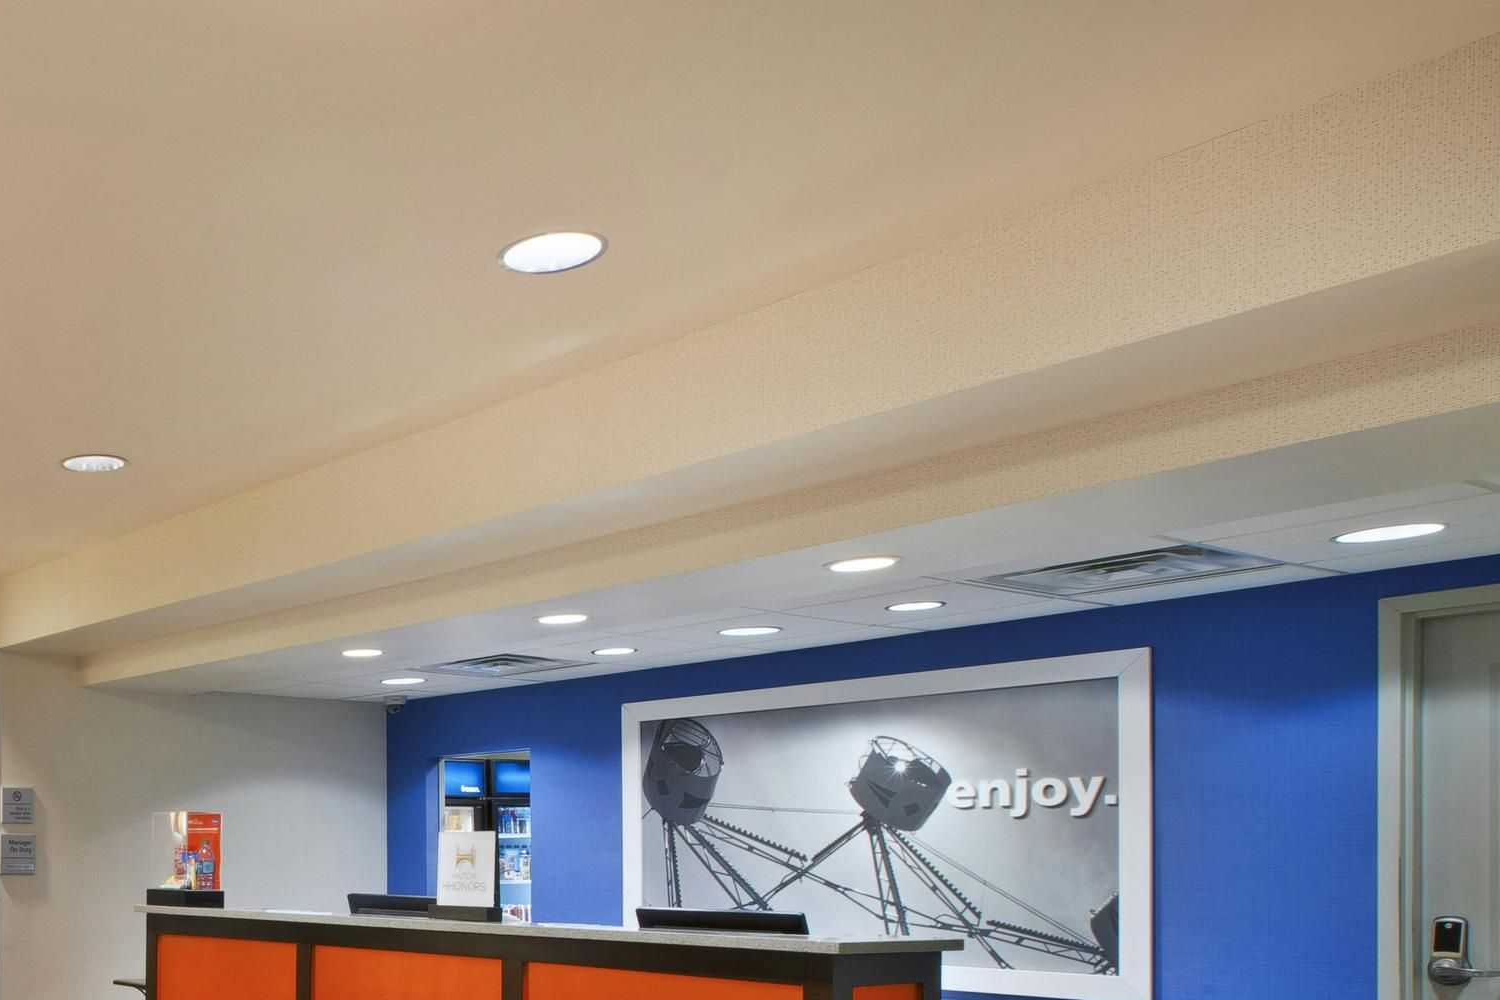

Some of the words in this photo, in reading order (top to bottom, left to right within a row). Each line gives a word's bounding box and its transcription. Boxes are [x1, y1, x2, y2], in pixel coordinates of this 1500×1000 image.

[949, 768, 1118, 818] enjoy.
[8, 839, 32, 847] Manager
[442, 881, 486, 892] HHONORS
